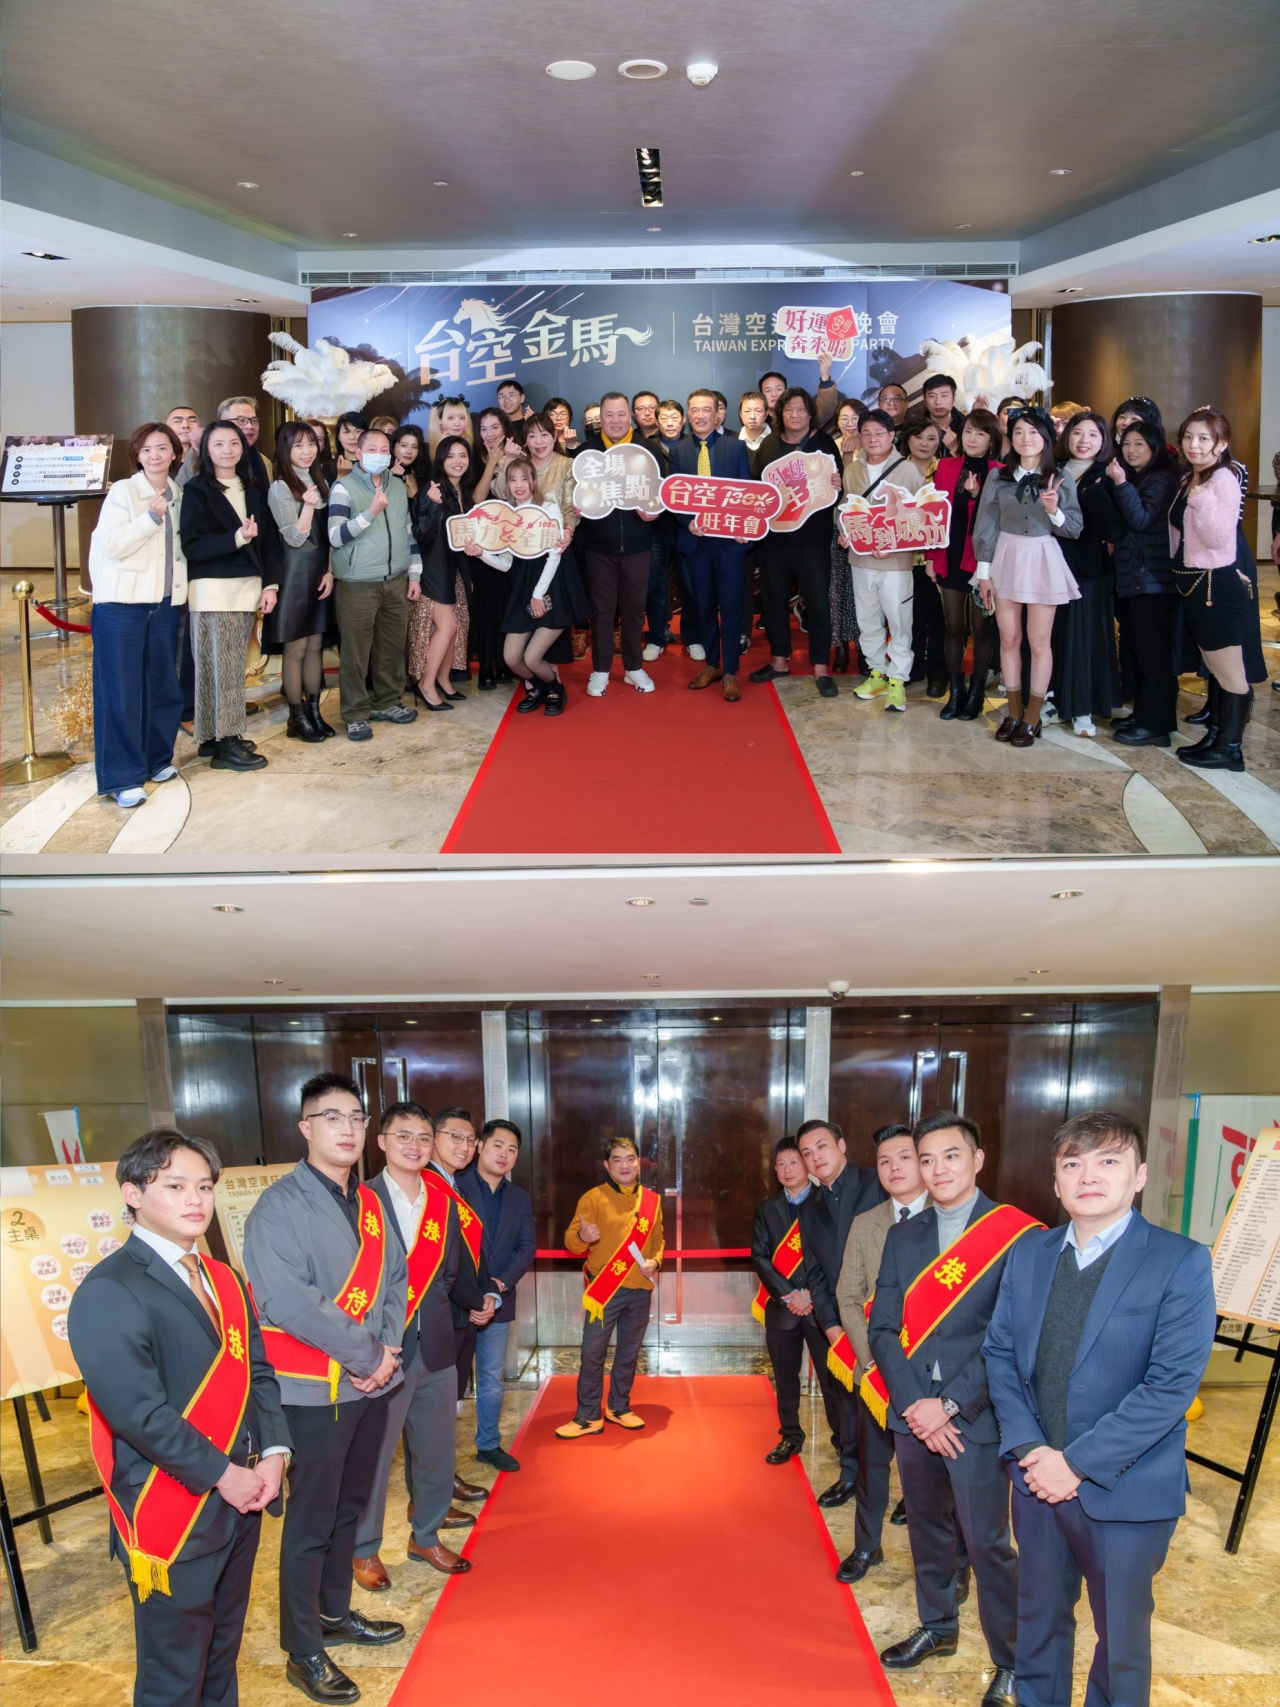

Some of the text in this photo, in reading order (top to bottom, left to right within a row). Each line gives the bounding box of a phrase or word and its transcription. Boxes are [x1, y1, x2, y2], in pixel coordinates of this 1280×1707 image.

[785, 309, 832, 335] 好運
[414, 308, 621, 386] 台空金馬
[694, 339, 747, 353] TAIWAN
[853, 338, 896, 351] PARTY
[789, 335, 849, 360] 奔來啦
[582, 453, 627, 479] 全場
[598, 474, 651, 508] 焦點
[669, 479, 719, 508] 台空
[703, 511, 762, 536] 旺年會
[843, 512, 948, 551] 馬到成功
[227, 1190, 253, 1198] TAIWAN
[10, 1210, 26, 1227] 2
[7, 1226, 40, 1243] 主桌
